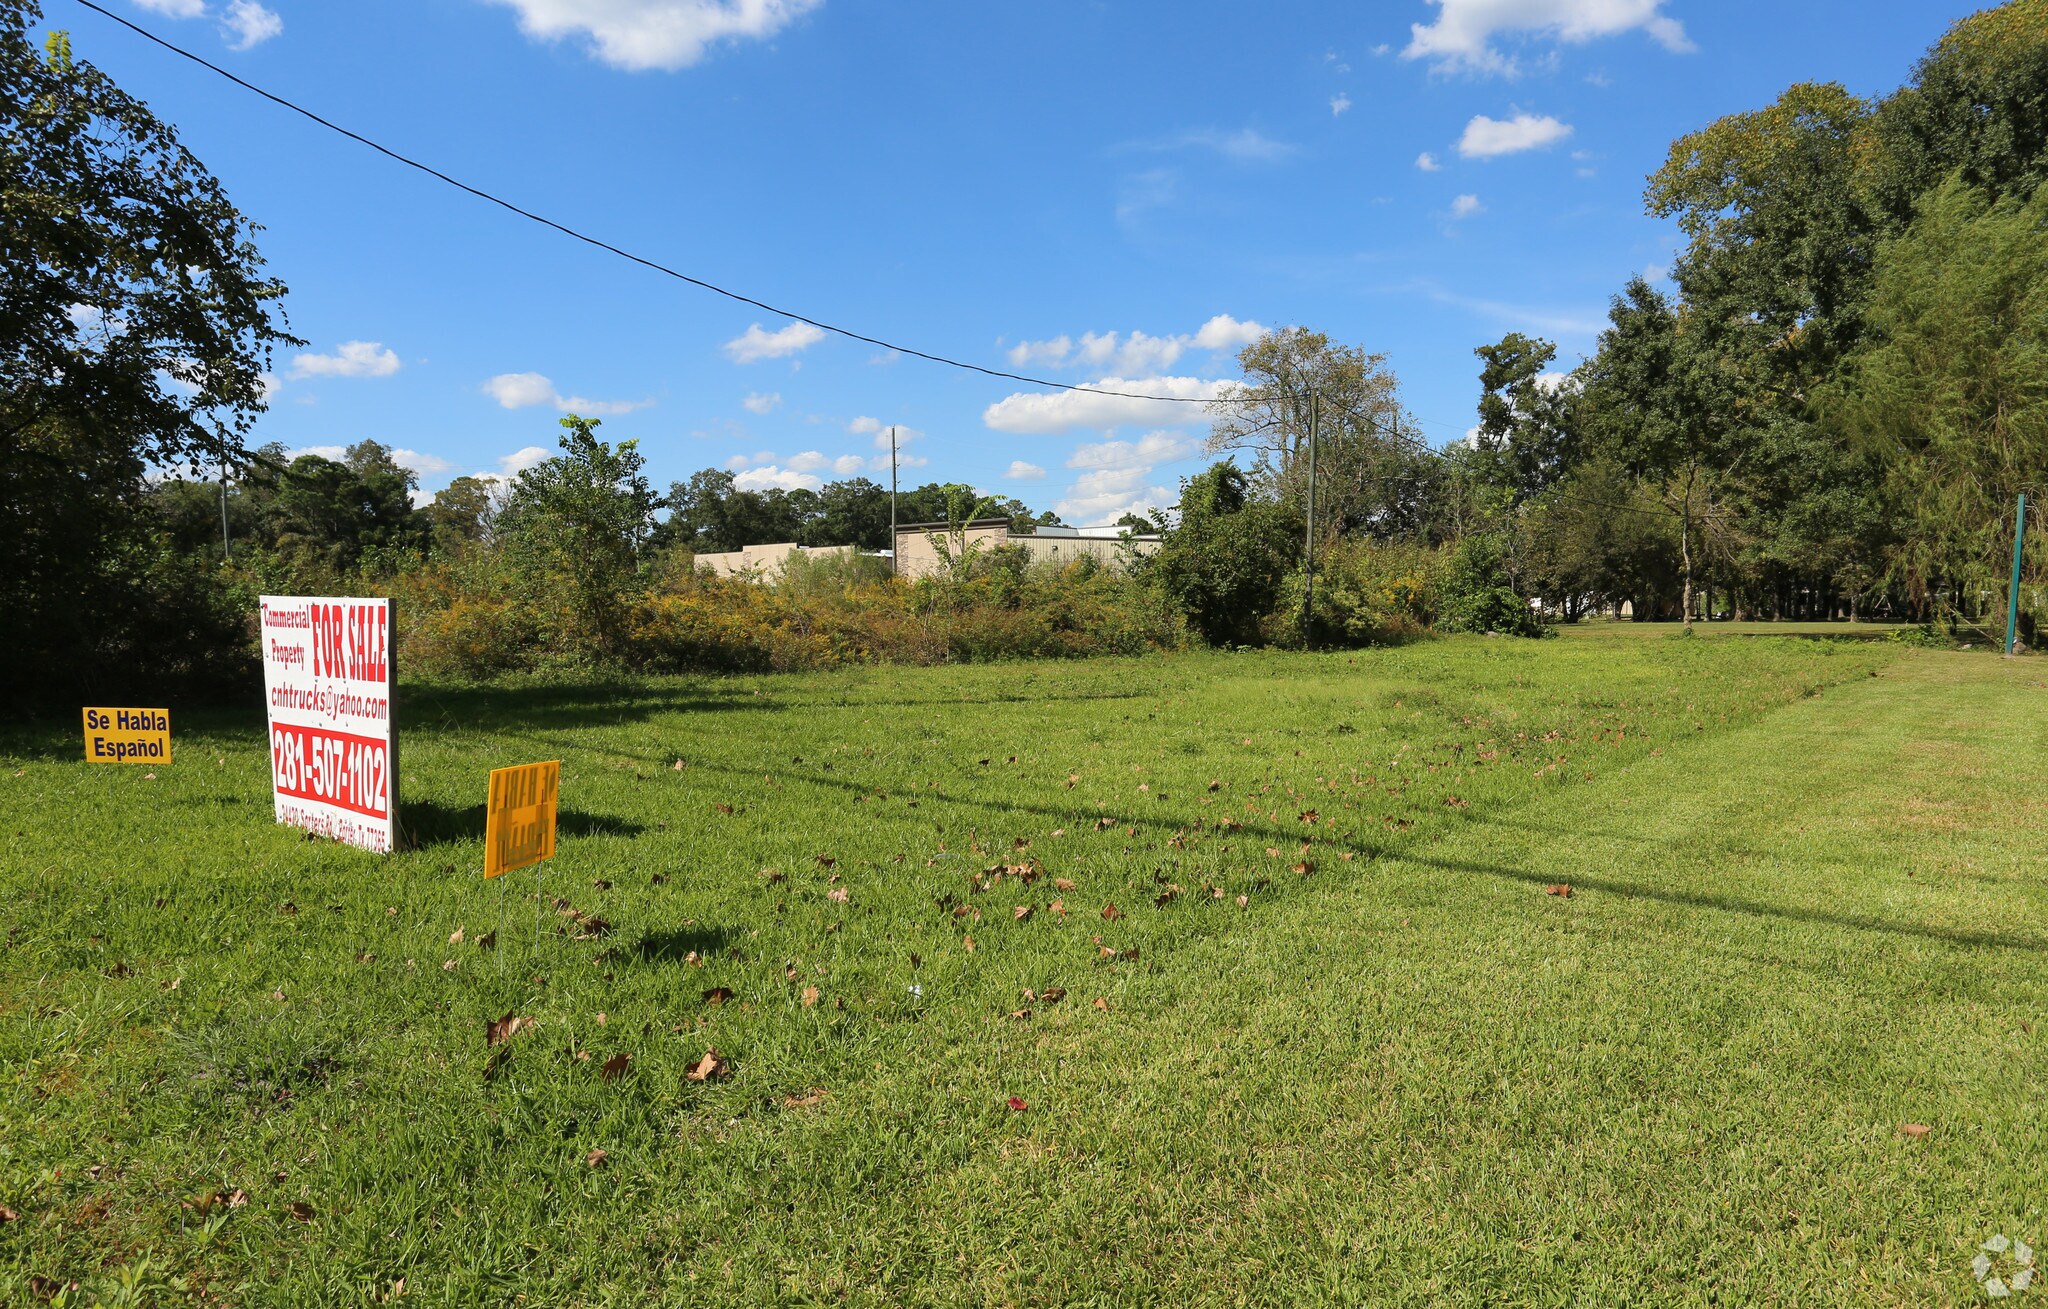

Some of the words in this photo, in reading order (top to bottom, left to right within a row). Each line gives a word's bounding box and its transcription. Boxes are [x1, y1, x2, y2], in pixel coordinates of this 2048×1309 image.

[263, 603, 310, 629] Commercial
[271, 638, 305, 671] Property
[311, 603, 346, 679] FOR
[348, 604, 386, 683] SALE
[271, 681, 387, 720] cnhtrucks@yahoo.com
[87, 709, 110, 730] Se
[116, 710, 167, 731] Habla
[94, 737, 164, 762] Español
[274, 729, 386, 812] 281-507-1102
